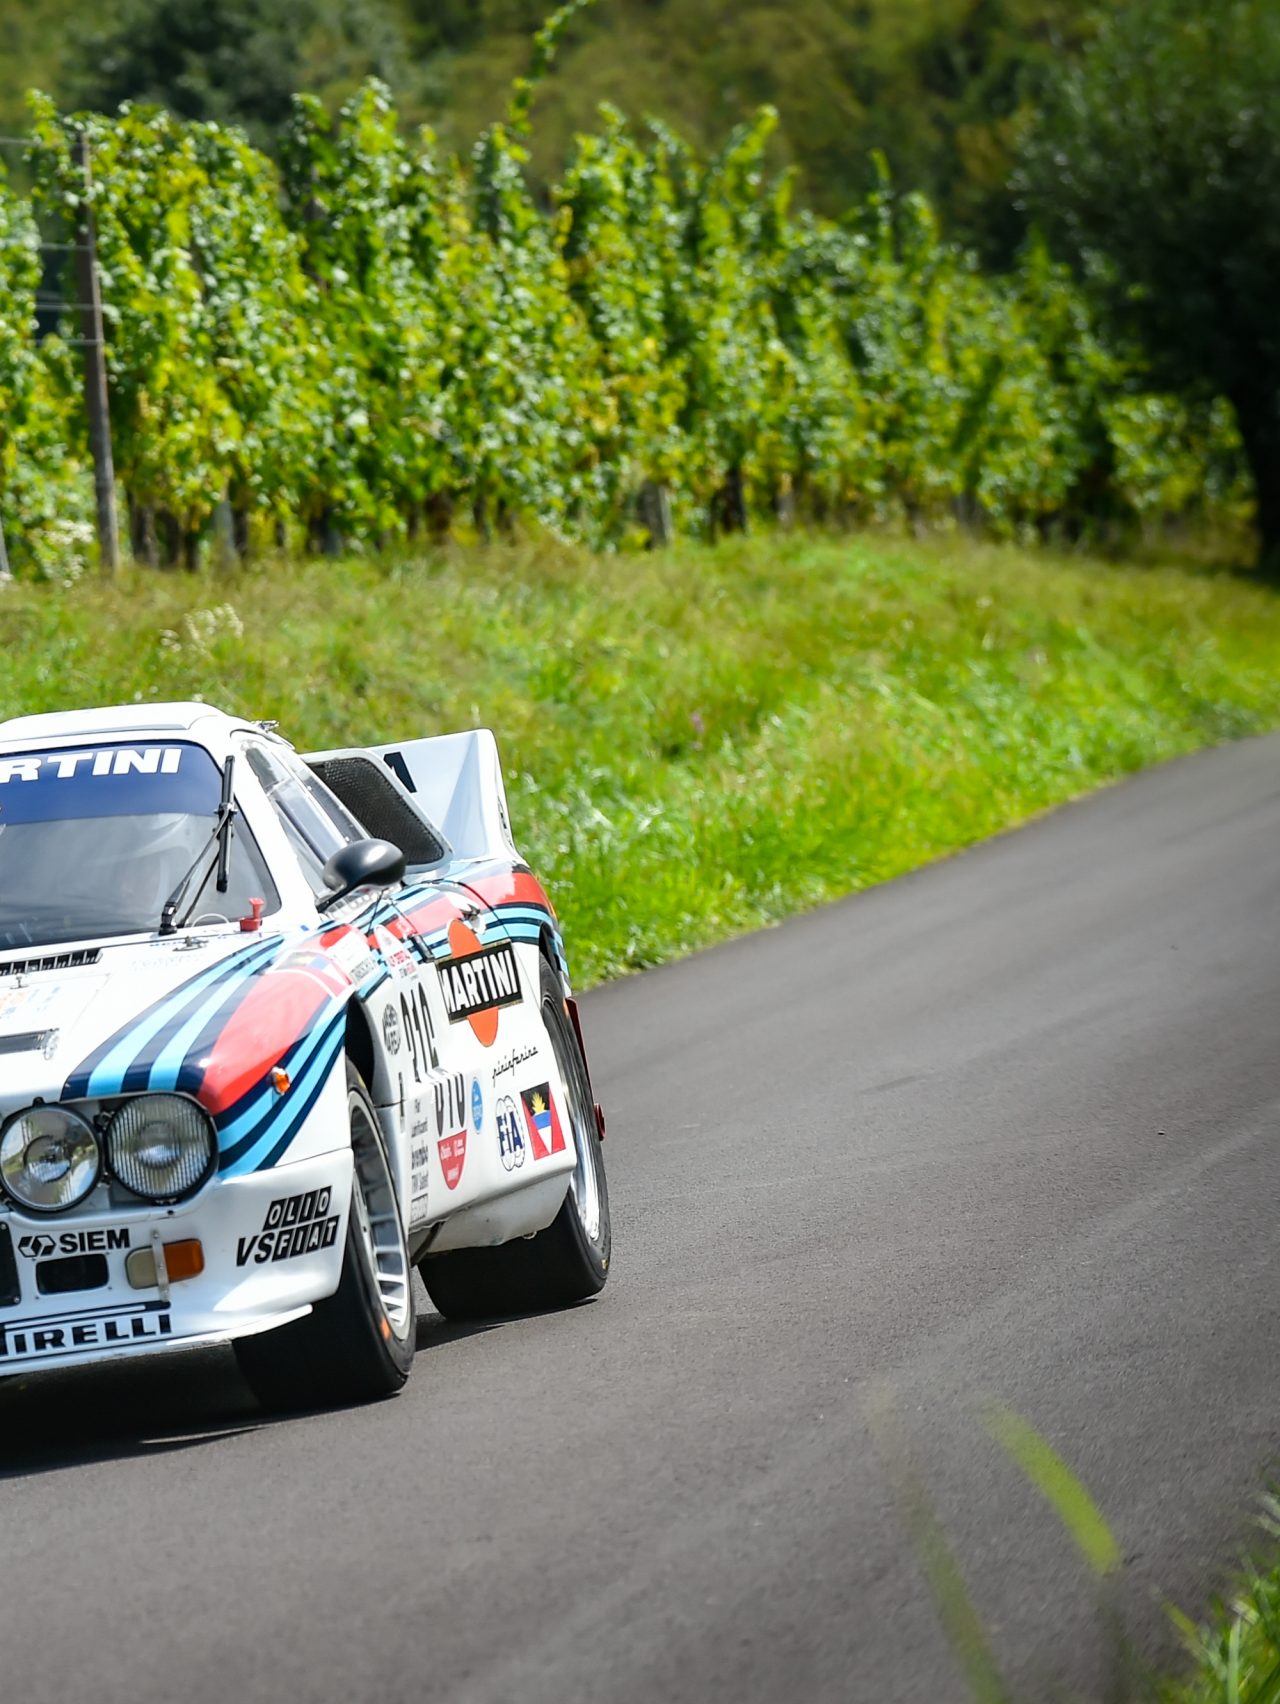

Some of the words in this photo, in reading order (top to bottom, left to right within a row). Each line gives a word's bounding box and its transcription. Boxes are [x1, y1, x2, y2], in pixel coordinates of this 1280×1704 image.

[437, 948, 521, 1015] MARTINI
[496, 1110, 524, 1157] FIA
[265, 1187, 331, 1229] OLIO
[58, 1227, 131, 1254] SIEM
